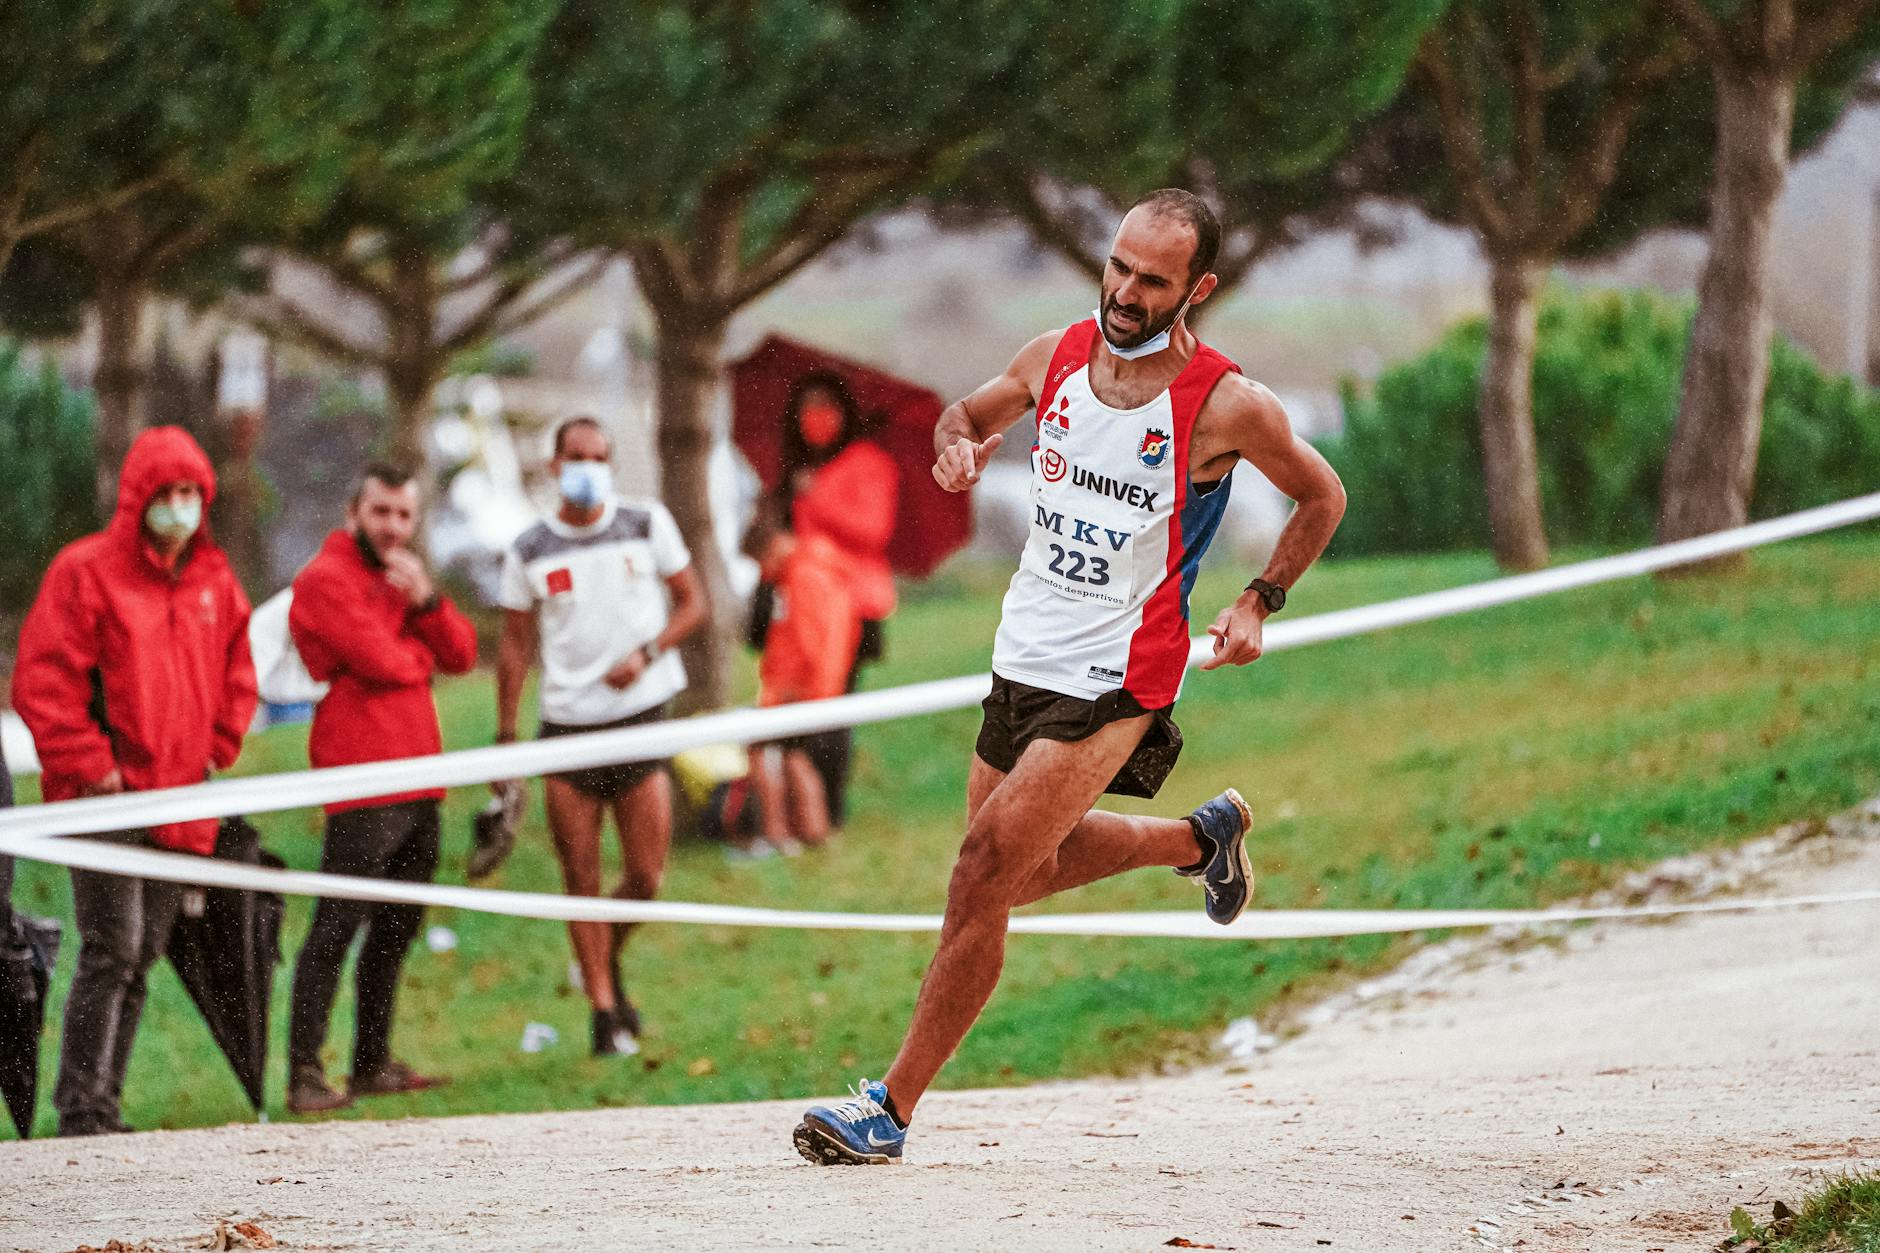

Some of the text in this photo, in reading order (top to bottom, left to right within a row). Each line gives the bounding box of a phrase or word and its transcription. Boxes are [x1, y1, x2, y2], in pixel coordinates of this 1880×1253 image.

[1072, 465, 1159, 512] UNIVEX
[1048, 543, 1110, 586] 223
[1064, 586, 1124, 605] desportivos
